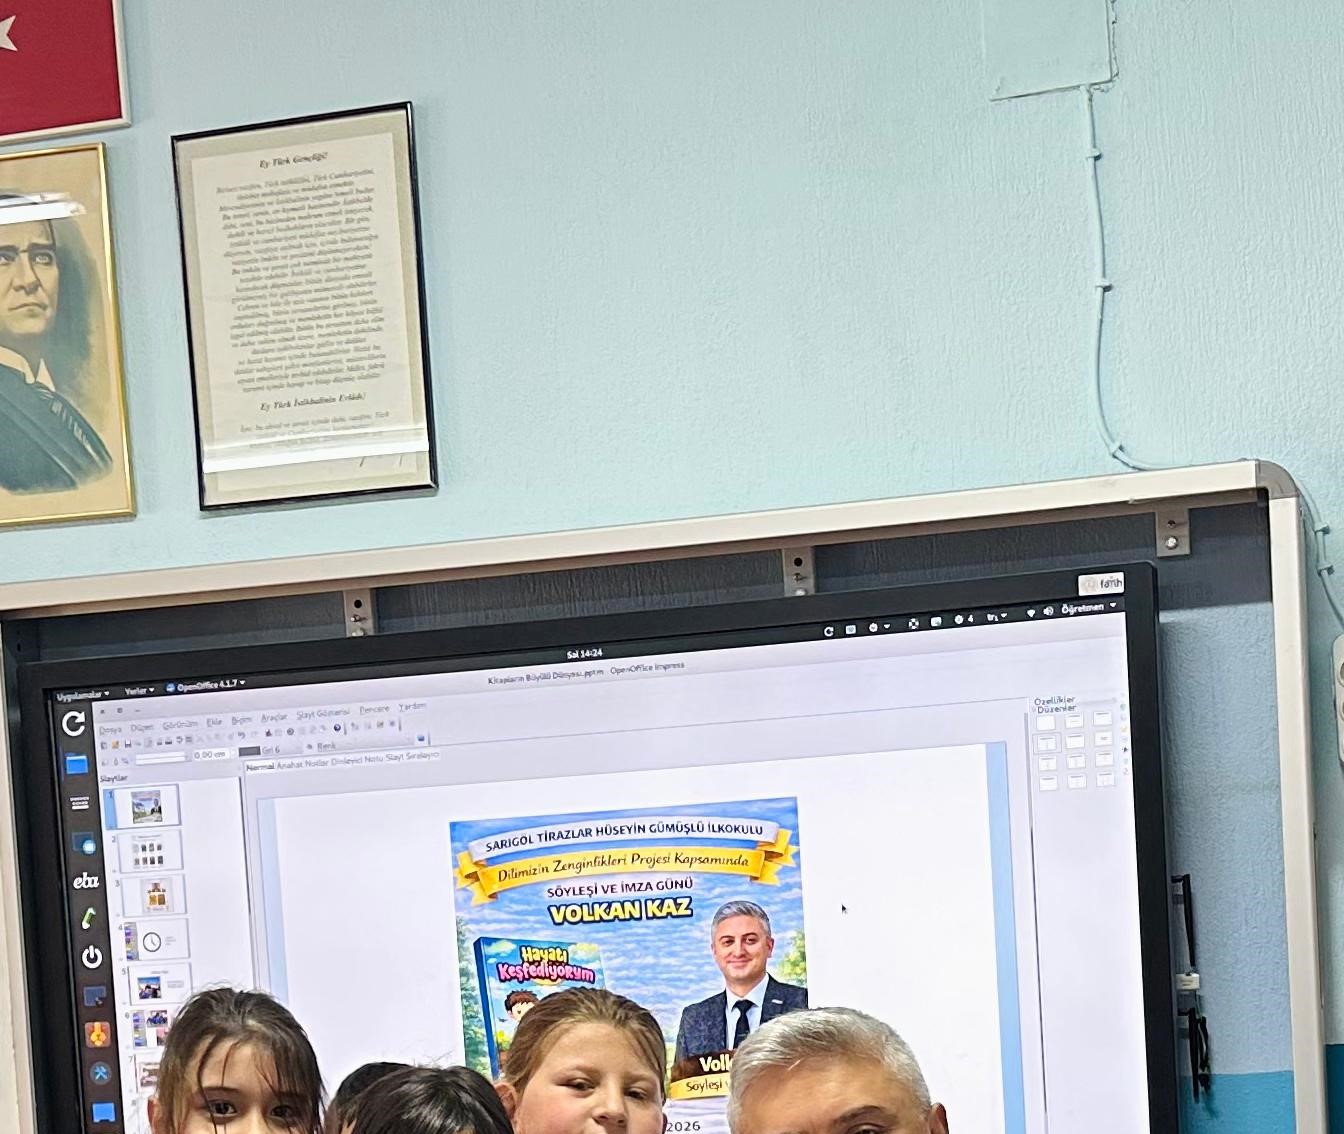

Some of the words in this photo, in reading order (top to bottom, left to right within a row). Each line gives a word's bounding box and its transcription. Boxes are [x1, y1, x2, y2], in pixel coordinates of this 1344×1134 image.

[1061, 602, 1105, 616] Öğretmen
[567, 649, 580, 659] Sal
[580, 648, 603, 658] 14:24
[124, 686, 147, 696] Yerler
[176, 681, 219, 693] OpenOffice
[219, 679, 238, 689] 4.1.7
[246, 762, 275, 772] Normal
[485, 834, 535, 853] SARIGÖL
[537, 826, 593, 843] TİRAZLAR
[595, 821, 647, 838] HÜSEYİN
[648, 820, 705, 836] GÜMÜŞLÜ
[707, 819, 764, 836] İLKOKULU
[497, 862, 550, 883] Dilimizin
[552, 853, 628, 875] Zenginlikleri
[630, 851, 671, 868] Projesi
[673, 850, 750, 869] Kapsamında
[72, 871, 100, 890] eba
[546, 881, 599, 899] SÖYLEŞİ
[600, 882, 618, 895] VE
[620, 878, 654, 894] İMZA
[655, 875, 694, 891] GÜNÜ
[549, 901, 643, 926] VOLKAN
[644, 895, 694, 919] KAZ
[520, 945, 568, 964] Hayatı
[698, 1053, 733, 1072] Volk
[685, 1079, 723, 1093] Söyleşi
[666, 1120, 701, 1132] 2026
